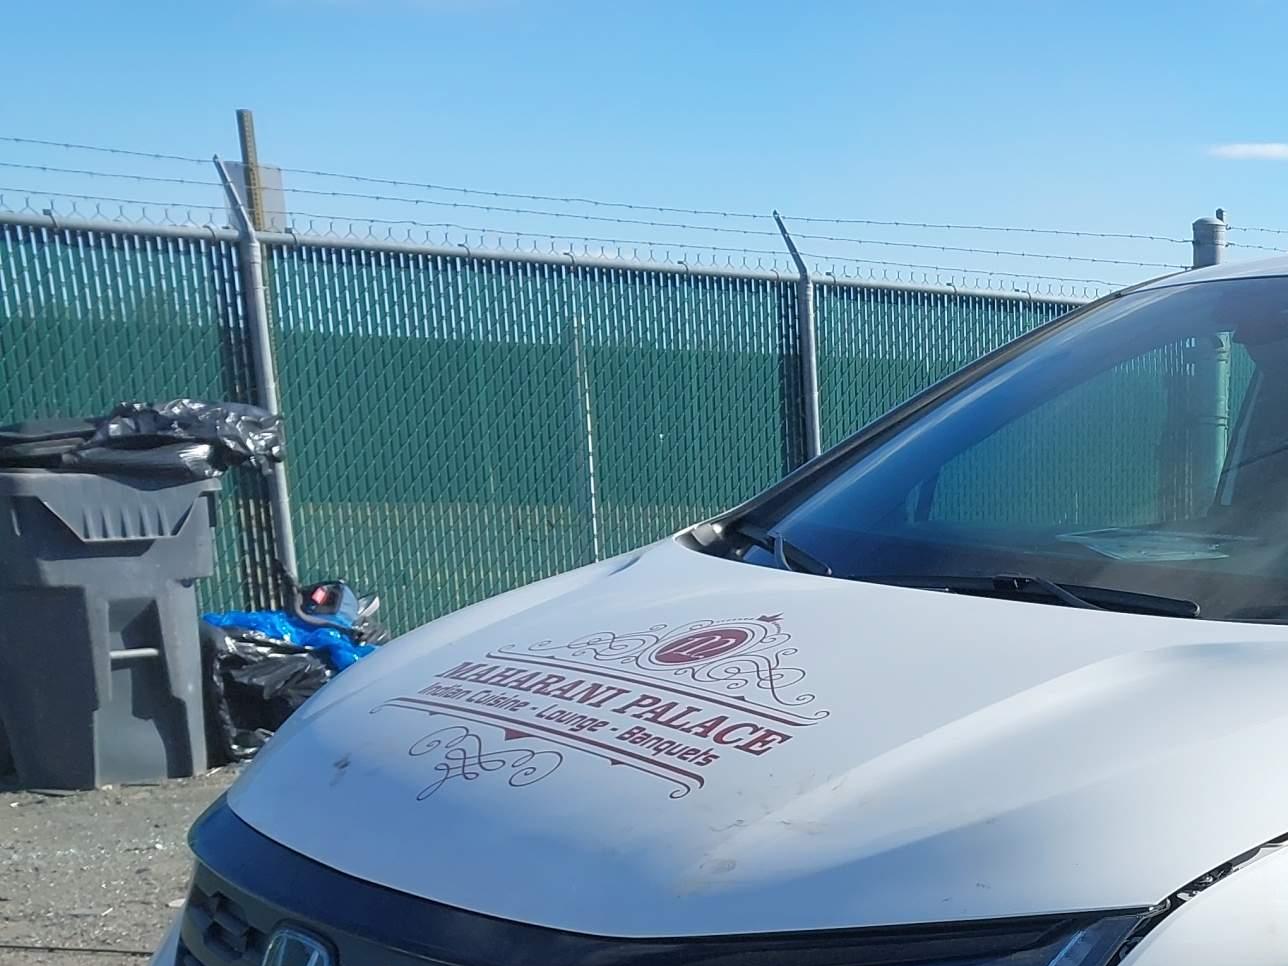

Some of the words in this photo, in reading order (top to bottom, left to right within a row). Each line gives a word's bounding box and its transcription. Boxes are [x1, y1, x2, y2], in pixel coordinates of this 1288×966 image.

[418, 682, 472, 700] Indian
[466, 690, 530, 712] Cuisine
[536, 704, 610, 732] Lounge
[616, 726, 720, 766] Banquets
[434, 661, 632, 708] MAHARANI
[612, 694, 793, 756] PALACE
